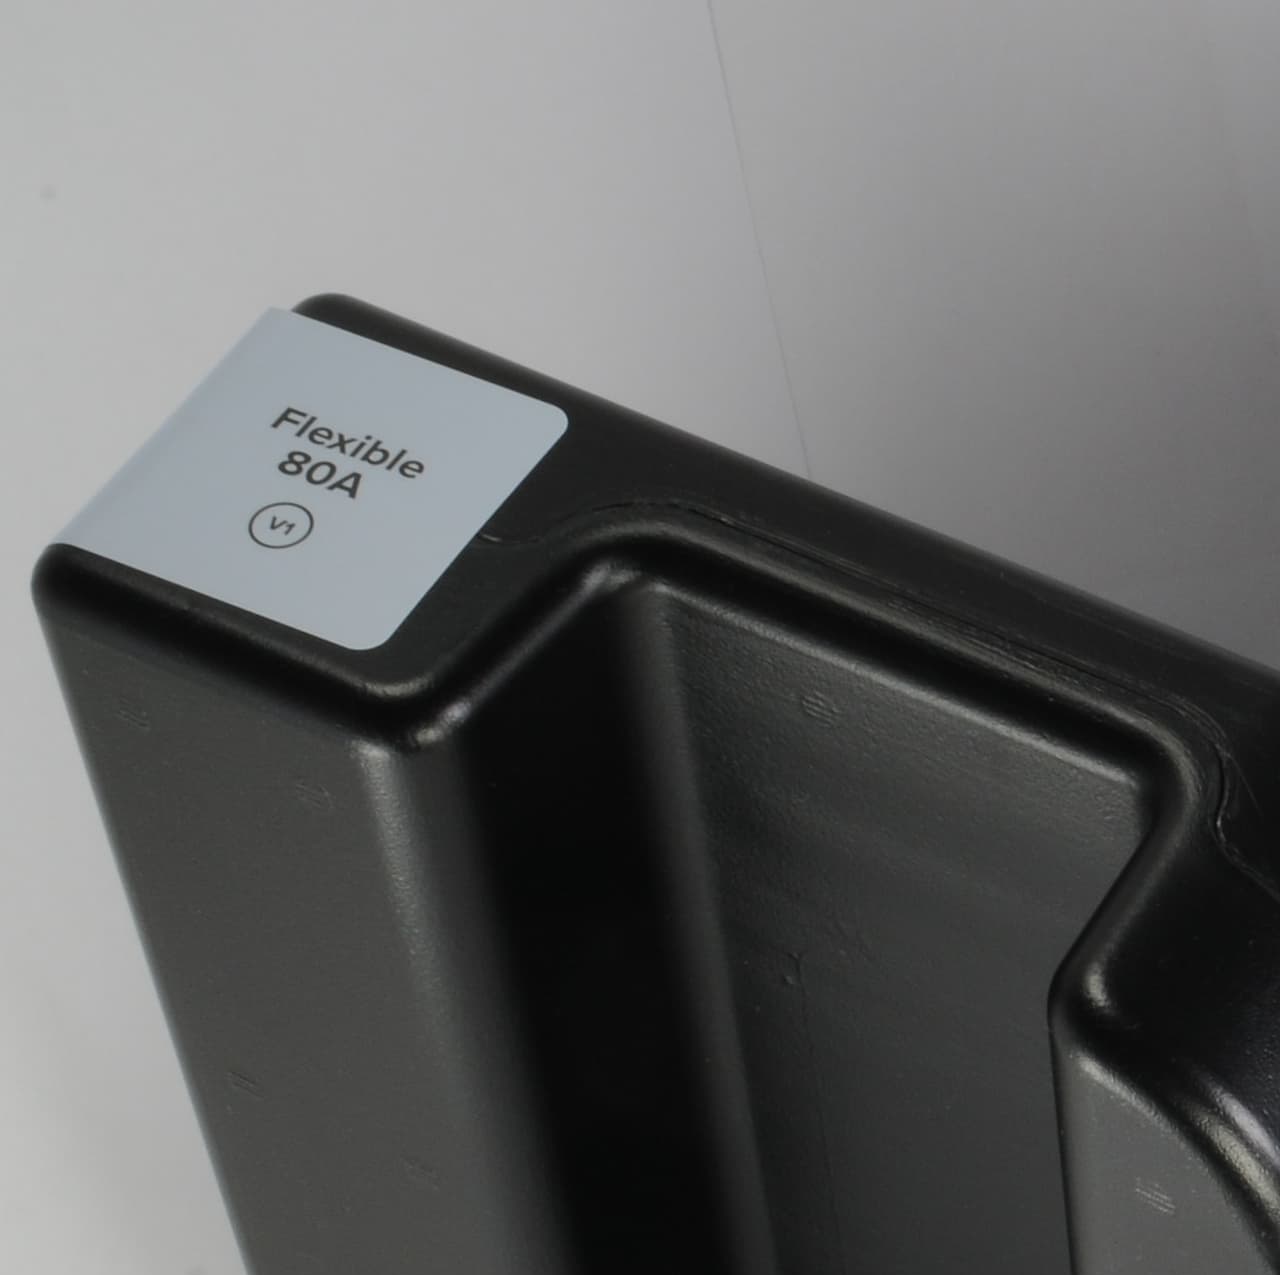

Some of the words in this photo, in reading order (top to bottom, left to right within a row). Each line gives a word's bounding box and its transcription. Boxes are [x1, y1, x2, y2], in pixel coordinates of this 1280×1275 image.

[271, 406, 425, 479] Flexible
[278, 451, 363, 499] 80A
[269, 516, 297, 536] V1
